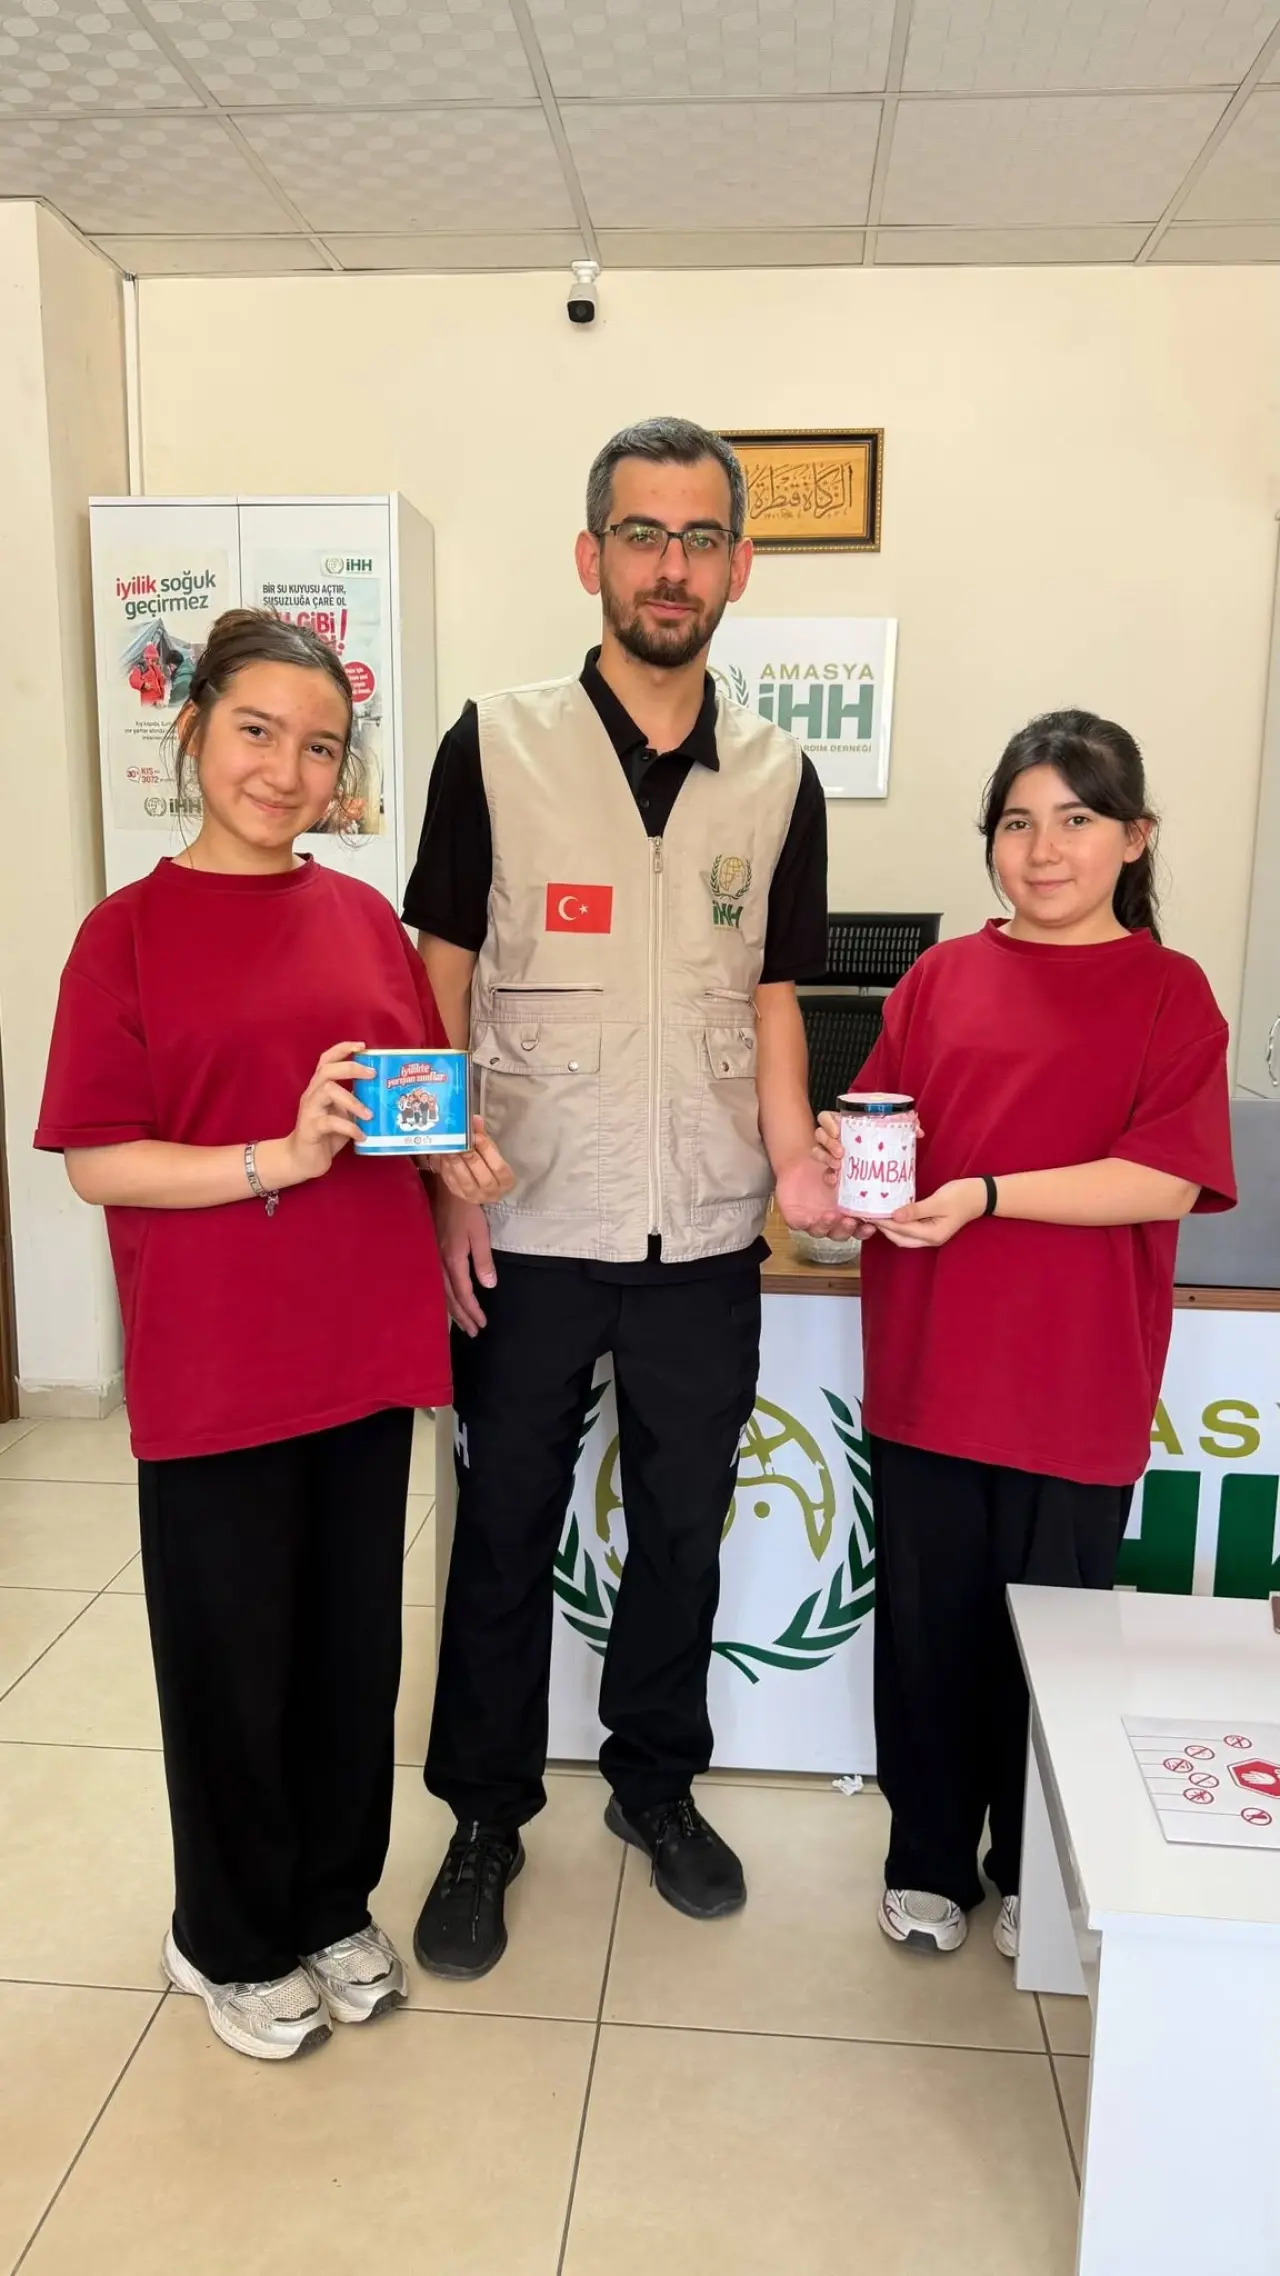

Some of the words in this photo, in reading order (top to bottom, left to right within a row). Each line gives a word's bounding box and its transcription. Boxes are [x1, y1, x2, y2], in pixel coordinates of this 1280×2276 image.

[115, 574, 157, 601] iyilik
[160, 569, 216, 595] soğuk
[262, 581, 276, 594] BİR
[277, 584, 288, 594] SU
[288, 584, 320, 594] KUYUSU
[125, 594, 209, 620] geçirmez
[263, 595, 311, 606] SUSUZLUĞA
[313, 596, 335, 609] ÇARE
[336, 596, 347, 606] OL
[760, 663, 875, 680] AMASYA
